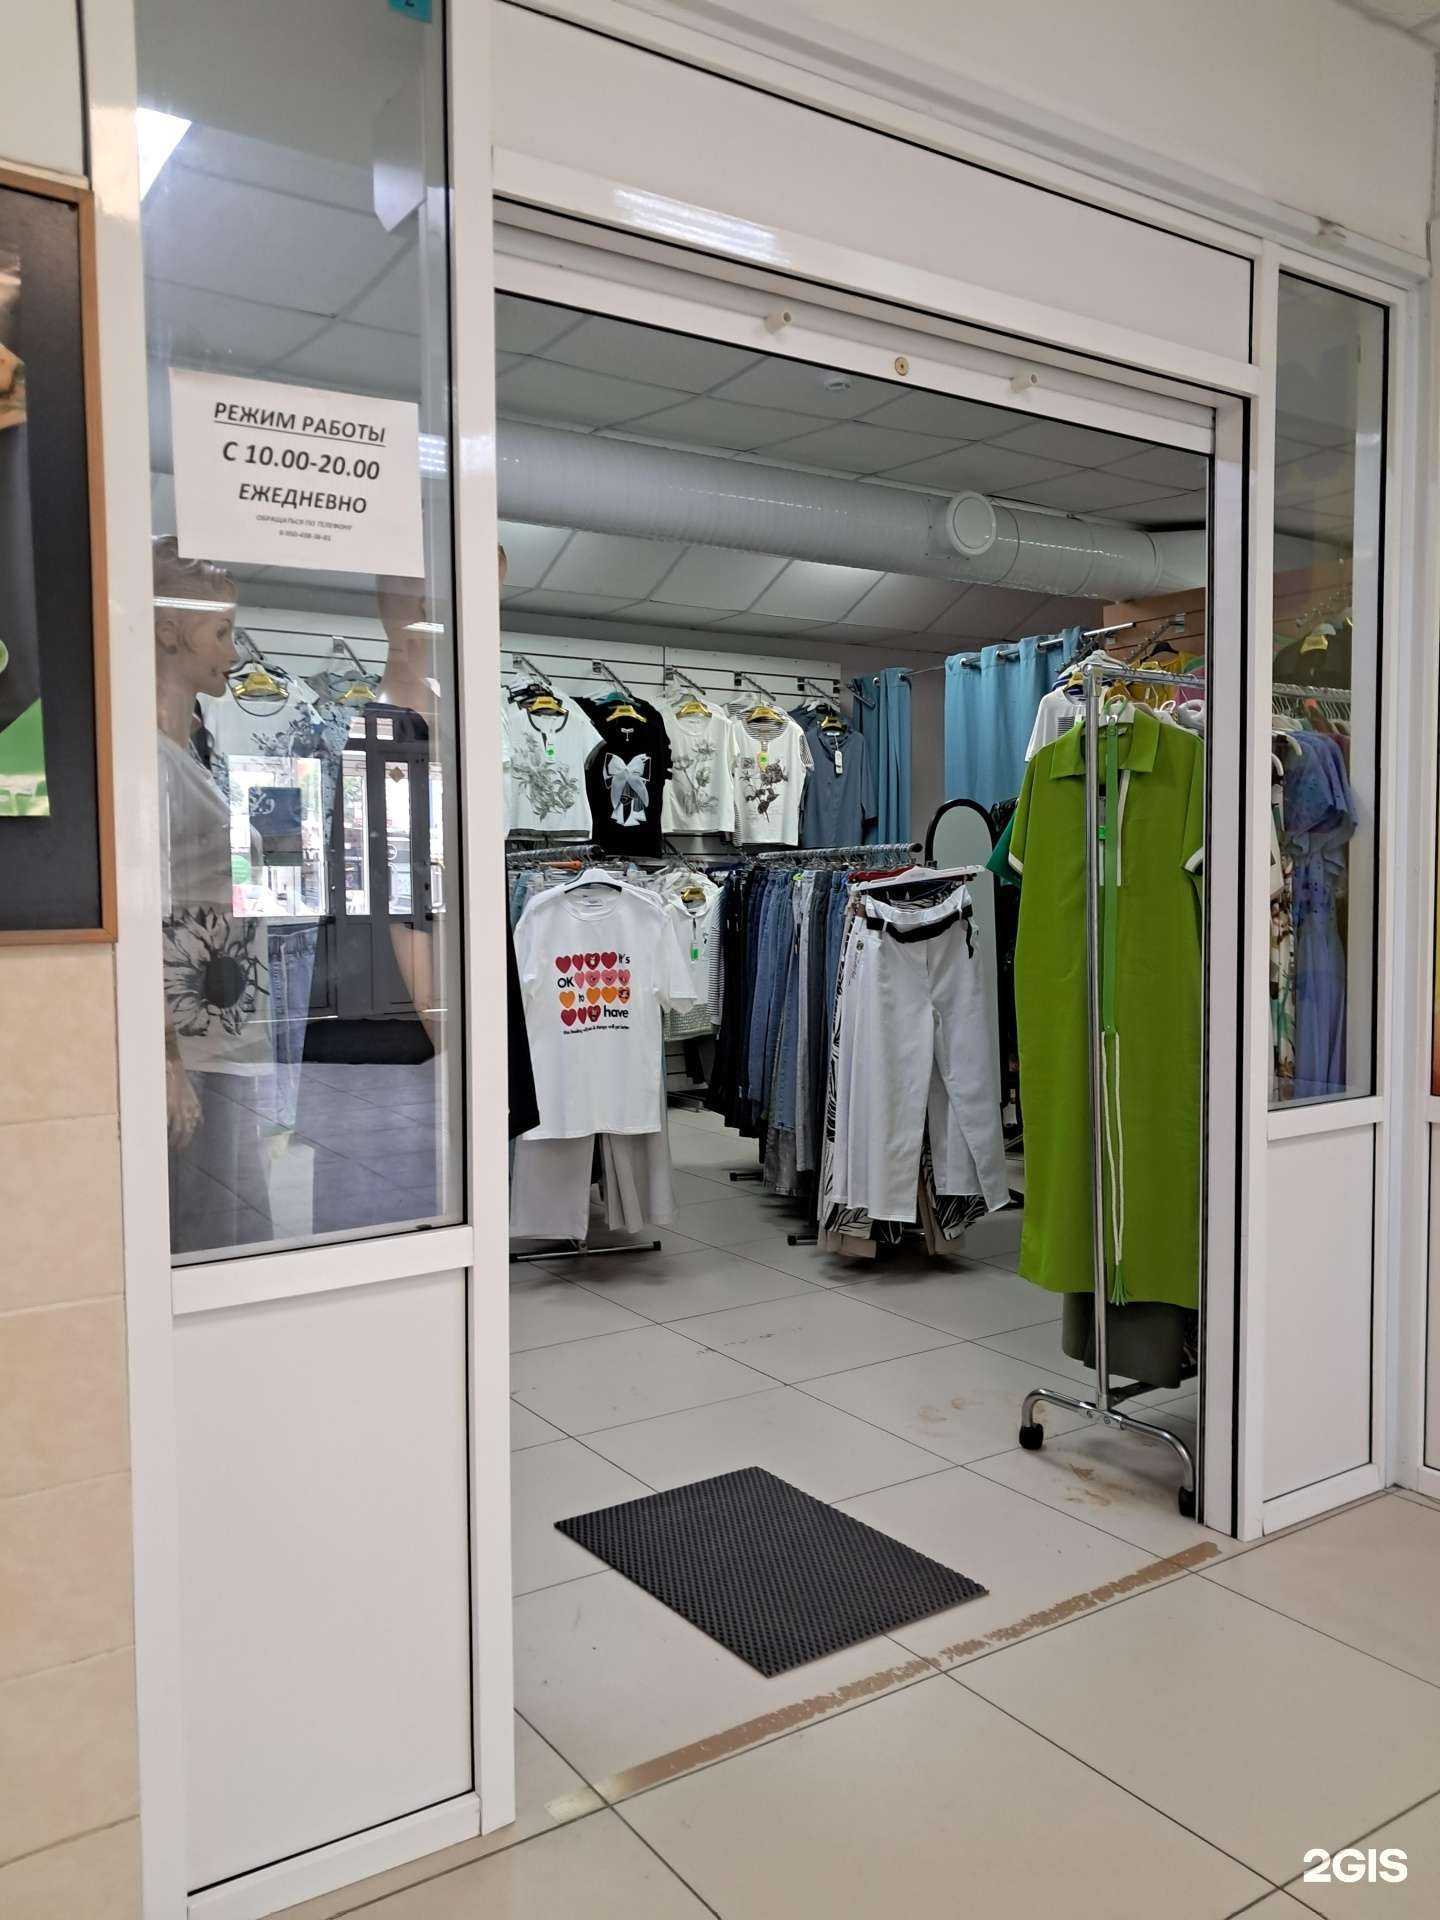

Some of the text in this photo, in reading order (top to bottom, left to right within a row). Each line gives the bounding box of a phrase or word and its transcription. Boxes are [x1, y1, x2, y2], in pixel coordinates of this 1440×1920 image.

[213, 401, 386, 443] РЕЖИМ РАБОТЫ
[222, 441, 380, 480] С 10.00-20.00
[238, 483, 367, 514] ЕЖЕДНЕВНО
[256, 514, 304, 525] ОБРАЩАТЬСЯ
[305, 519, 315, 527] ПО
[557, 977, 575, 989] OK
[603, 1004, 629, 1018] have
